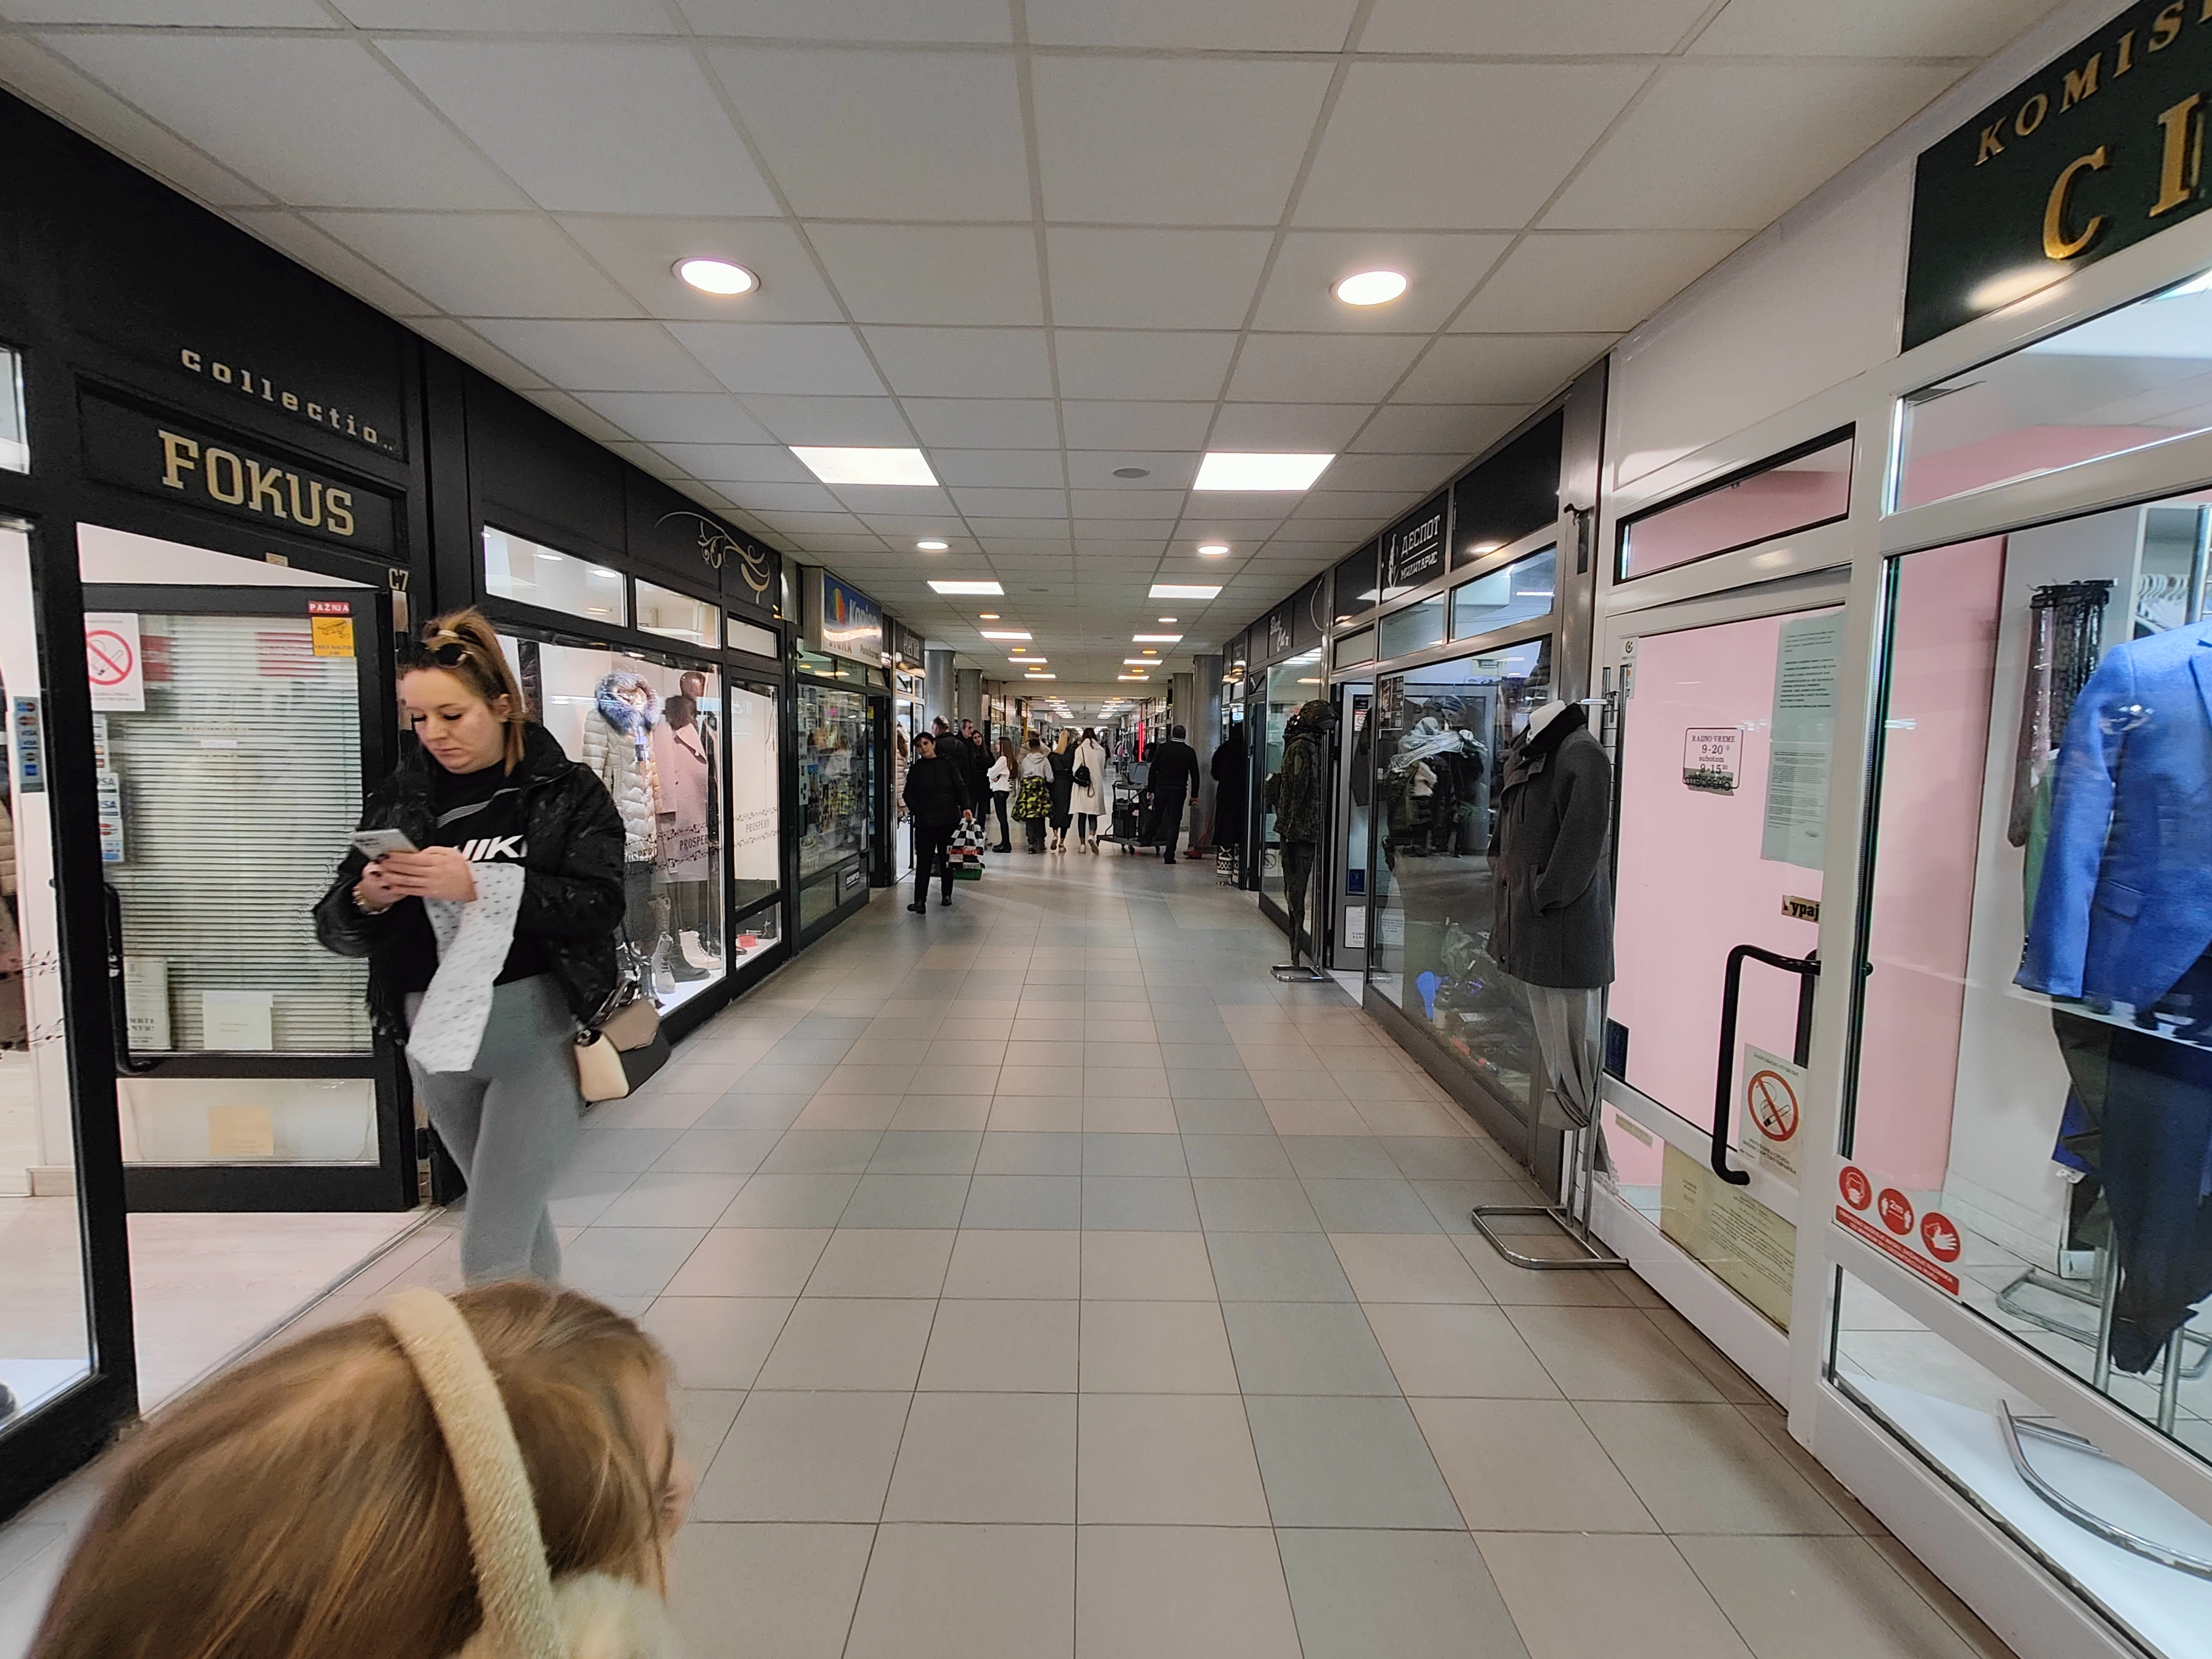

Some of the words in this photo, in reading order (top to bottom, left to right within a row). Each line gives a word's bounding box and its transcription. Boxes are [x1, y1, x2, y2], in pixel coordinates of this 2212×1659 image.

[181, 348, 397, 451] collectio
[159, 429, 355, 536] FOKUS
[1401, 514, 1441, 558] ДЕСПОТ
[1400, 551, 1438, 581] МИЛИТАРИС
[389, 568, 409, 591] C7
[1701, 744, 1723, 755] 9-20
[745, 818, 769, 833] PROSPERO
[679, 834, 709, 851] PROSPER
[1784, 901, 1820, 922] урај
[1889, 1199, 1904, 1214] 2m
